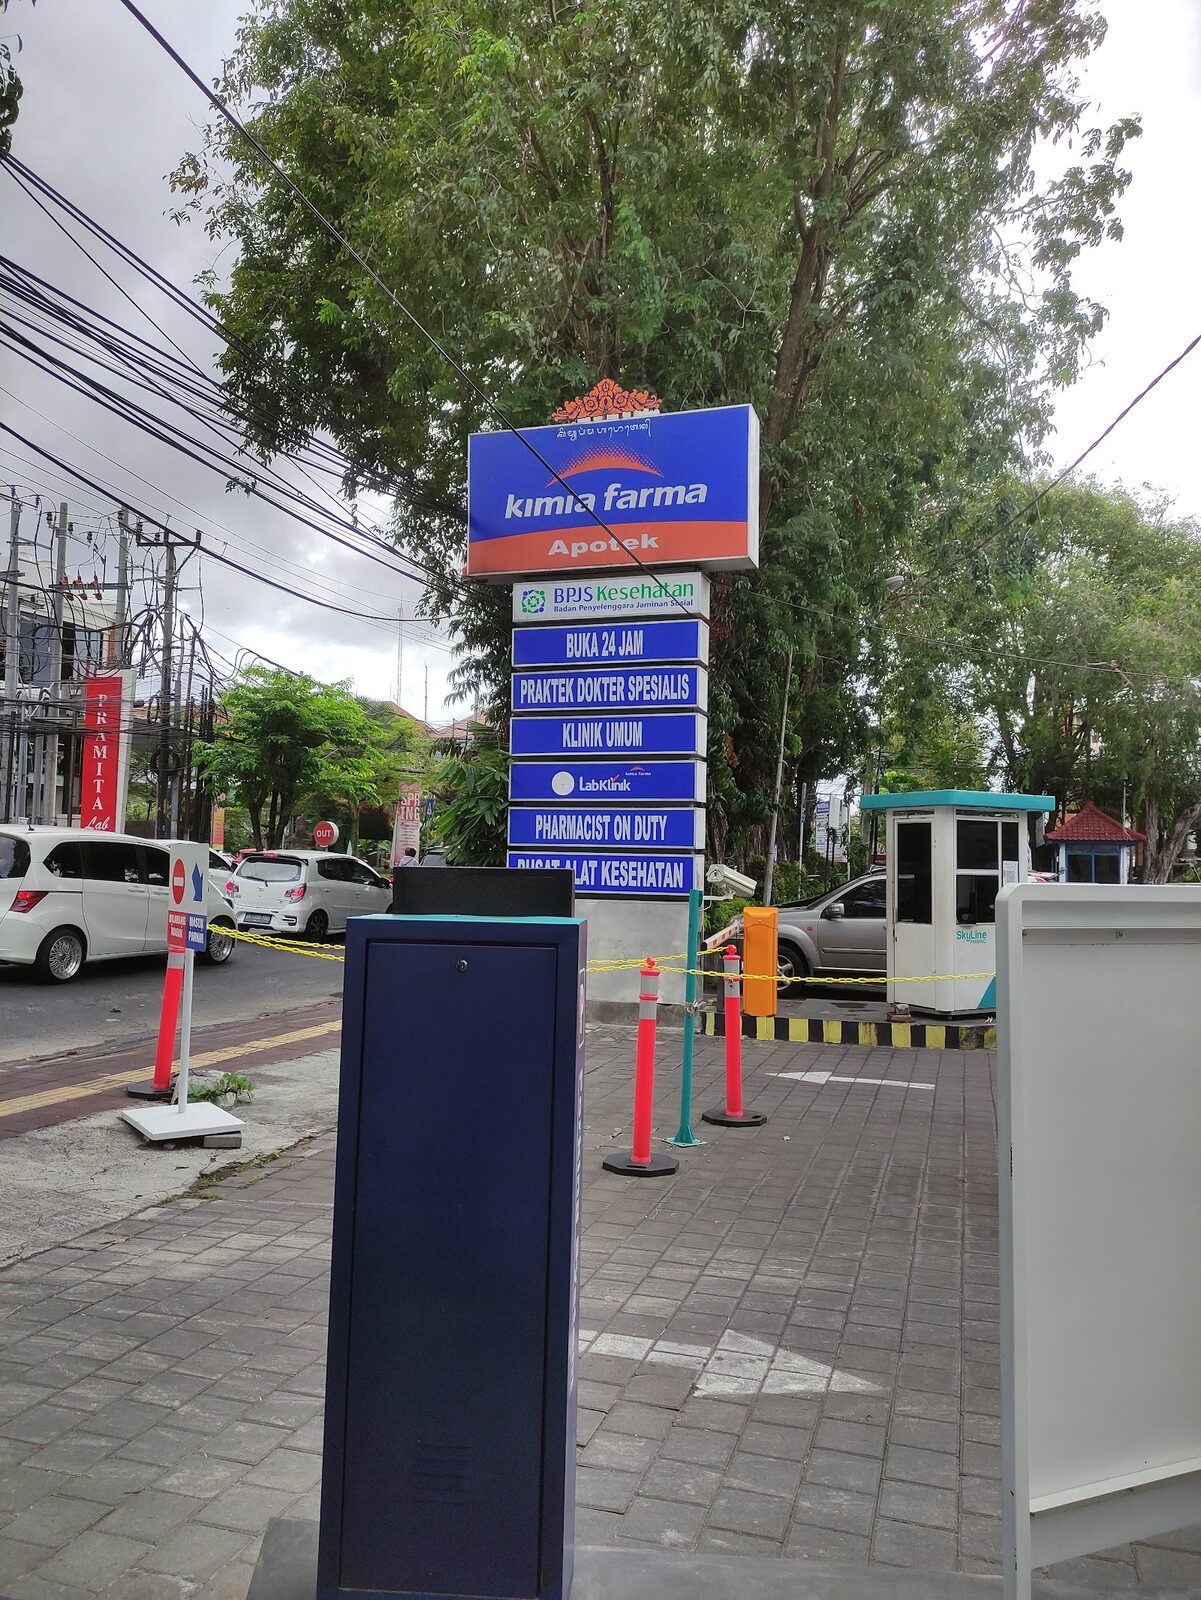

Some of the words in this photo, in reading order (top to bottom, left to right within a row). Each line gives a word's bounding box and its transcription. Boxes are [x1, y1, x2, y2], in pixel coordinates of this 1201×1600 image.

[505, 494, 596, 518] kimia
[604, 483, 707, 511] farma
[548, 533, 659, 557] Apotek
[554, 587, 593, 603] BPJS
[597, 583, 694, 601] Kesehatan
[579, 603, 635, 613] Penyelenggara
[636, 601, 669, 609] Jaminan
[566, 632, 599, 658] BUKA
[602, 631, 615, 656] 24
[619, 630, 644, 656] JAM
[520, 678, 574, 704] PRAKTEK
[577, 676, 625, 702] DOKTER
[628, 673, 689, 700] SPESIALIS
[562, 722, 603, 747] KLINIK
[606, 721, 643, 747] UMUM
[92, 694, 108, 810] PRAMITA
[579, 776, 631, 791] LabKlinik
[85, 816, 110, 830] Lab
[316, 829, 332, 838] OUT
[536, 815, 610, 840] PHARMACIST
[614, 815, 631, 840] ON
[634, 816, 667, 841] DUTY
[601, 861, 683, 888] KESEHATAN
[956, 930, 987, 941] SkyLine
